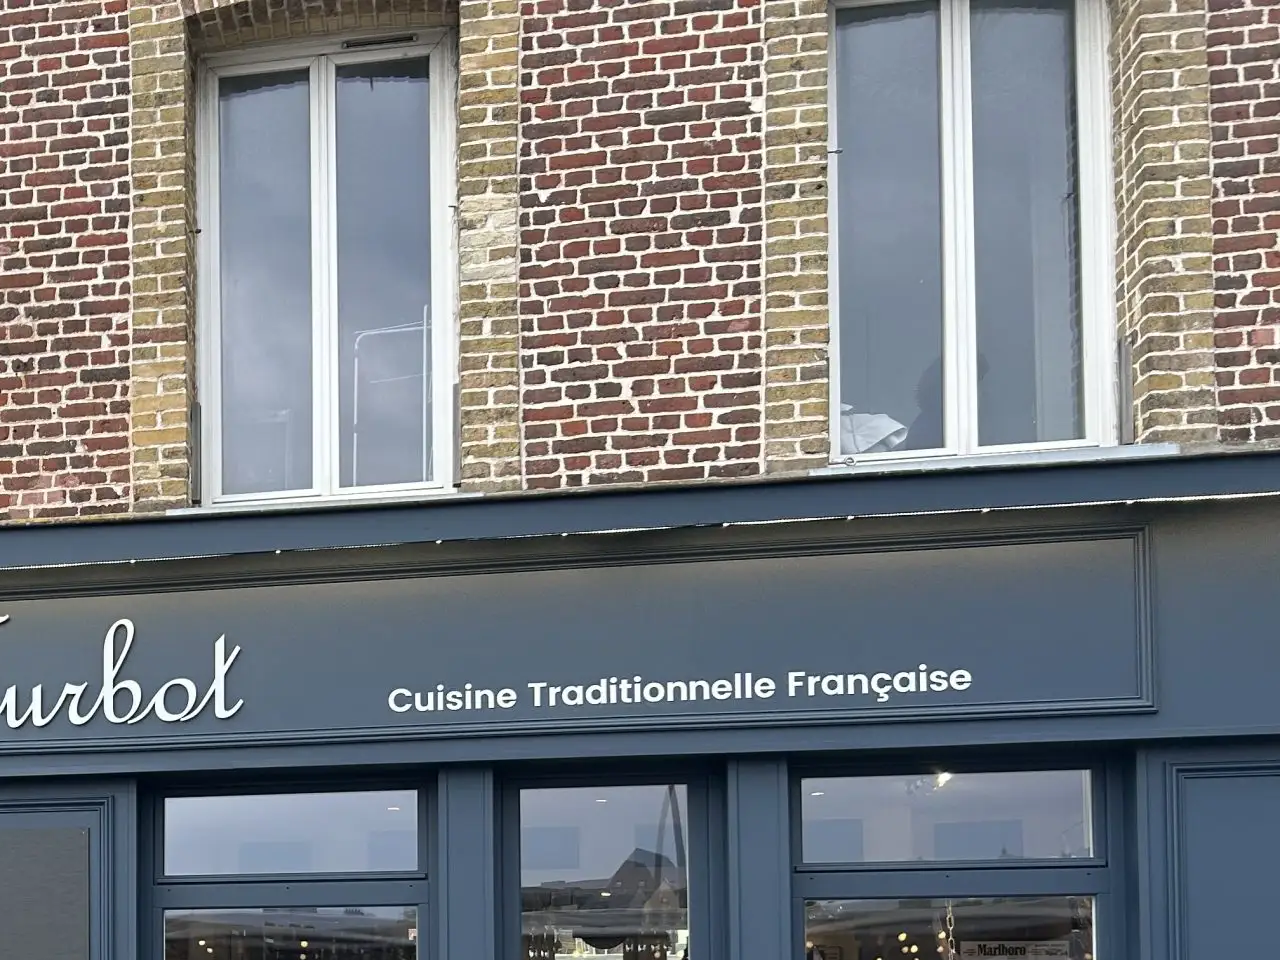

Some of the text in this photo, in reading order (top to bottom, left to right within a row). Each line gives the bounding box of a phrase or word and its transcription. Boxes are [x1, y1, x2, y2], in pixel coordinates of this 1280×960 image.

[387, 663, 973, 713] Cuisine Traditionnelle Française
[977, 944, 1026, 957] Marlboro
